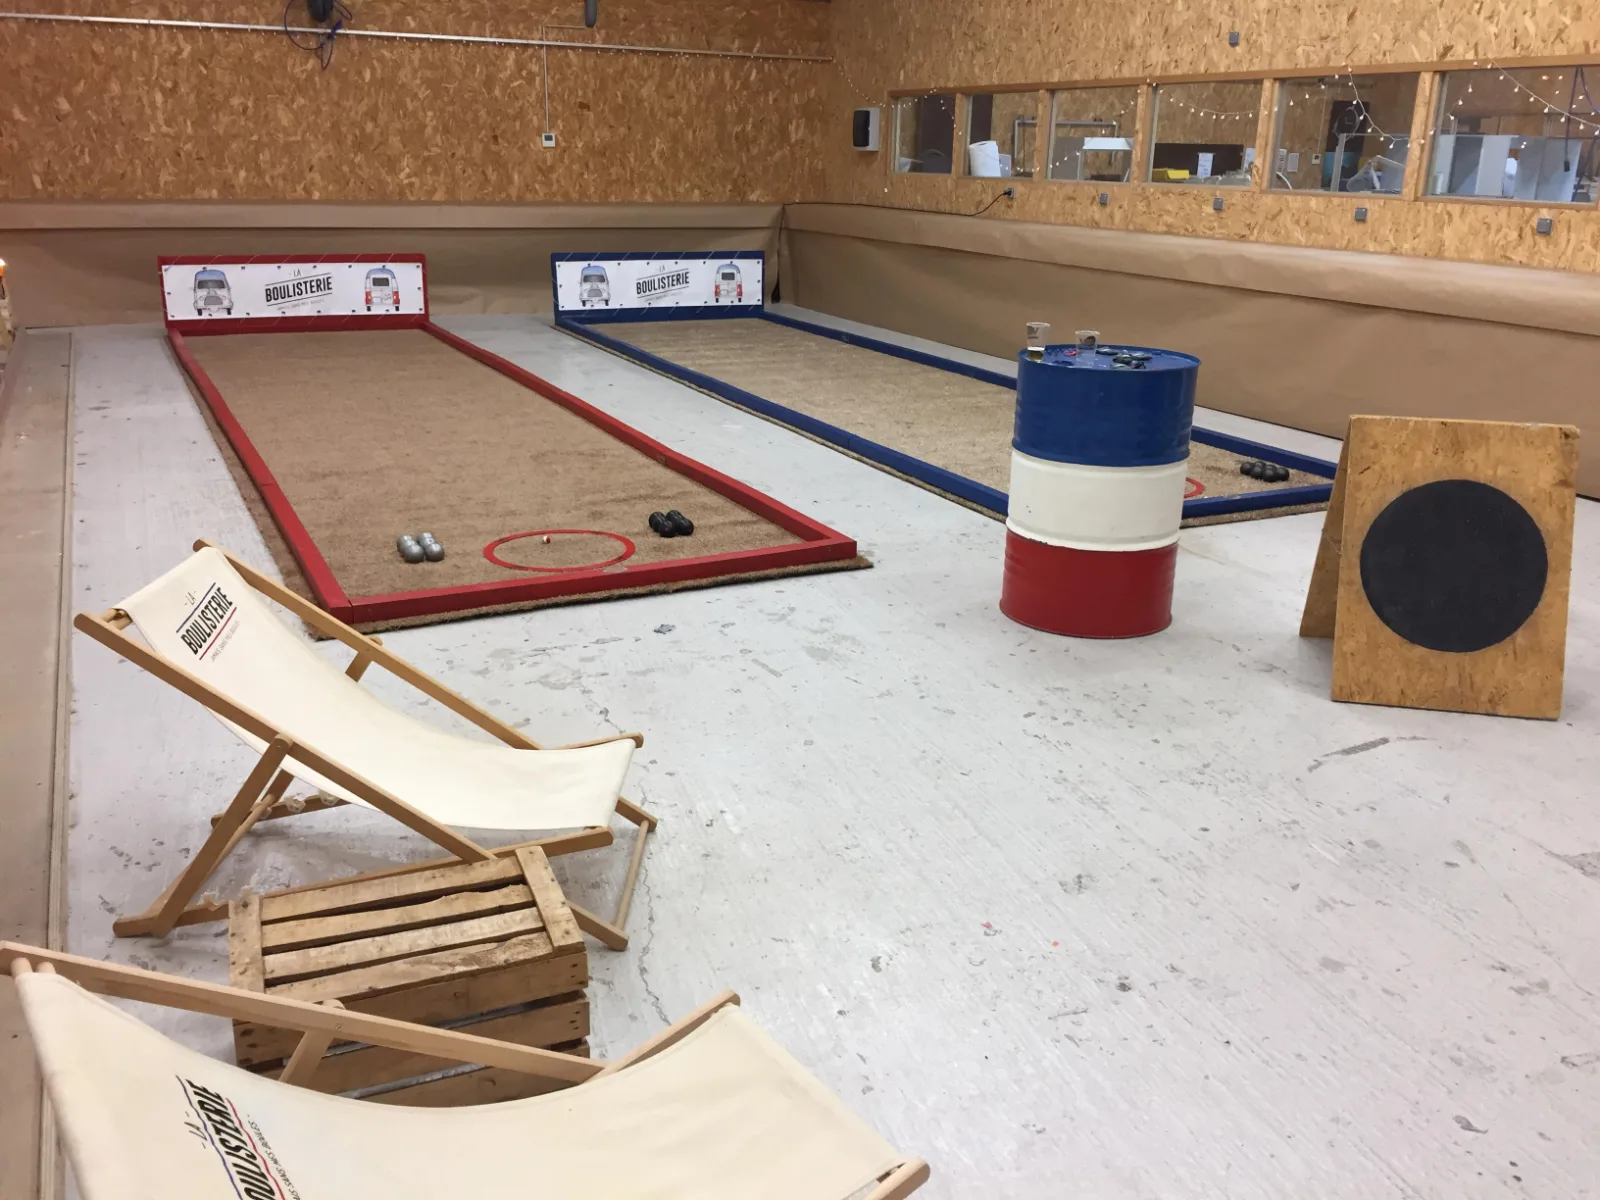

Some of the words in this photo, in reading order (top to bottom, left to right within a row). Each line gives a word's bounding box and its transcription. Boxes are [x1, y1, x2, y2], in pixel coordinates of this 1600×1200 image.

[293, 268, 302, 277] LA
[659, 265, 666, 273] LA
[265, 276, 333, 302] BOULISTERIE
[636, 271, 690, 295] BOULISTERIE
[185, 591, 197, 606] LA
[180, 587, 233, 655] BOULISTERIE
[184, 1121, 208, 1141] LA
[185, 1079, 276, 1200] OULISTERIE
